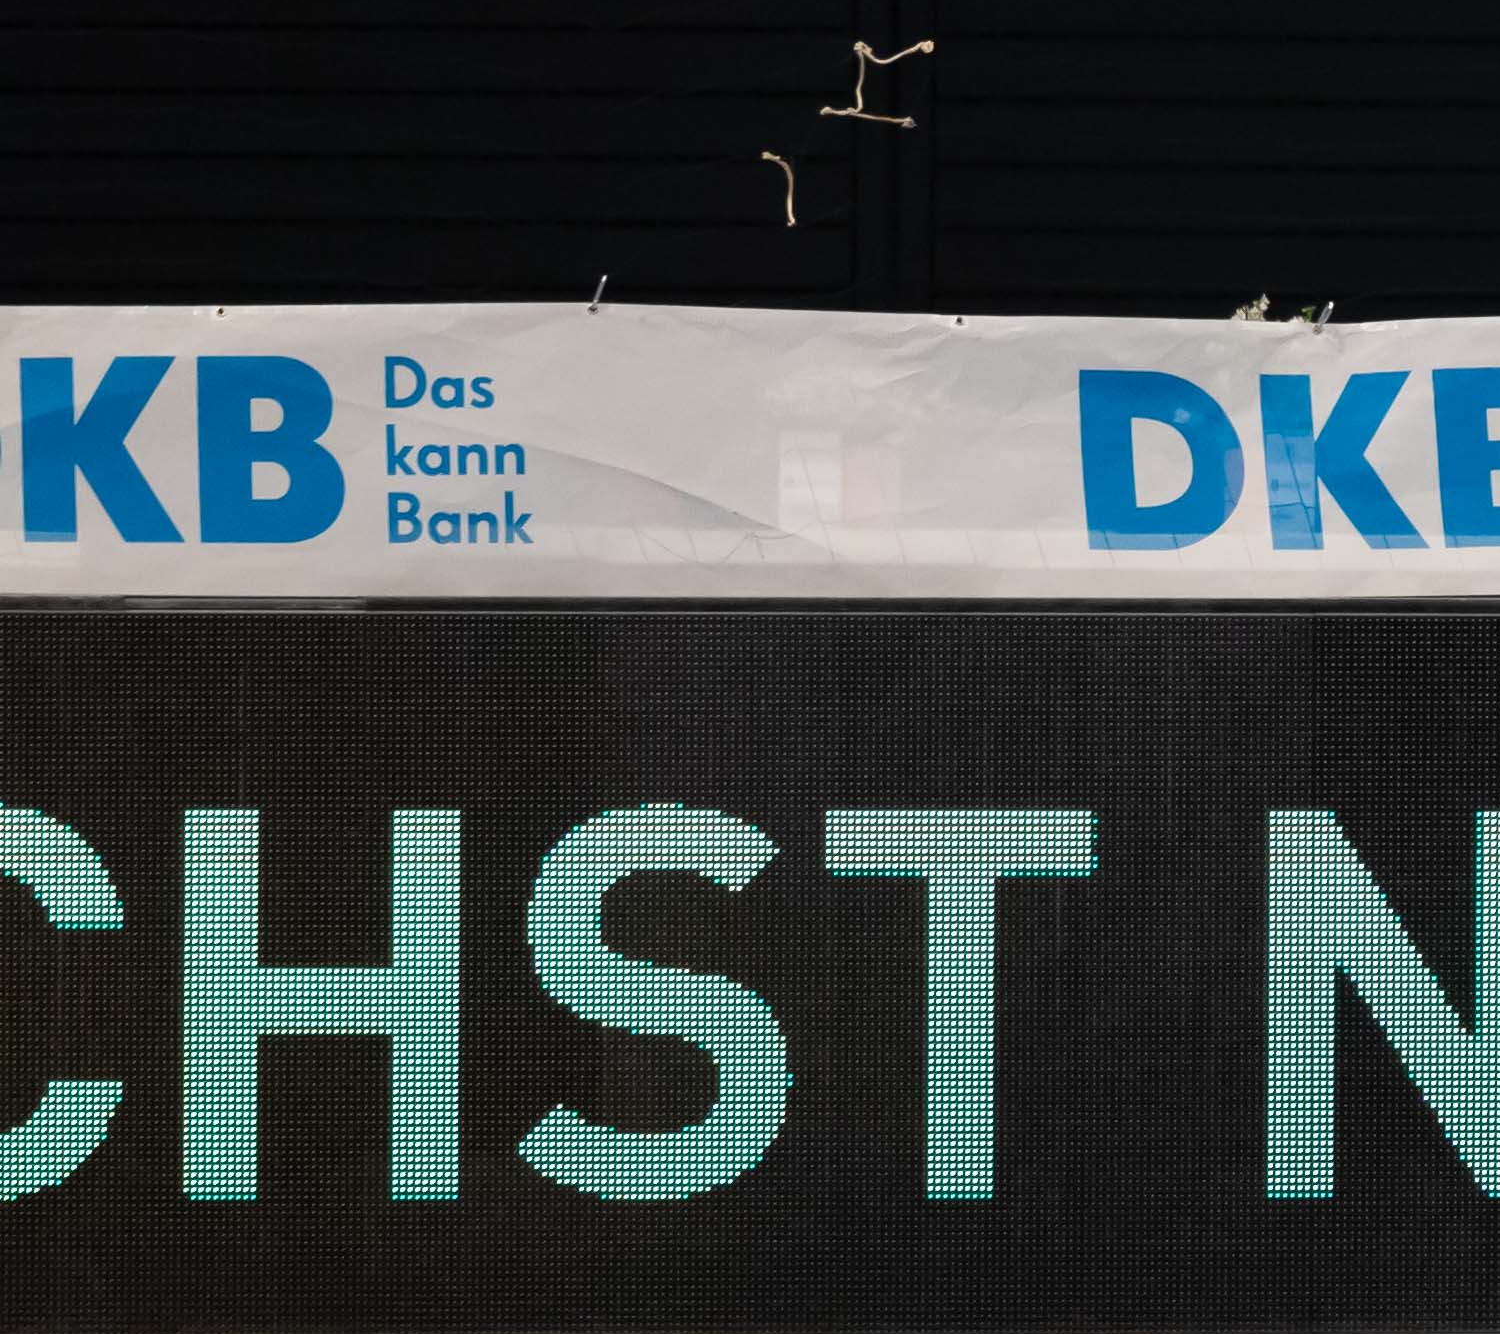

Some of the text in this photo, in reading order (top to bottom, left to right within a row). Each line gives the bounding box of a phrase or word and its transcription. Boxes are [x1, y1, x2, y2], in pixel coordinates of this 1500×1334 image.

[384, 356, 495, 409] Das
[0, 356, 345, 543] KB
[386, 424, 526, 476] kann
[389, 492, 533, 545] Bank
